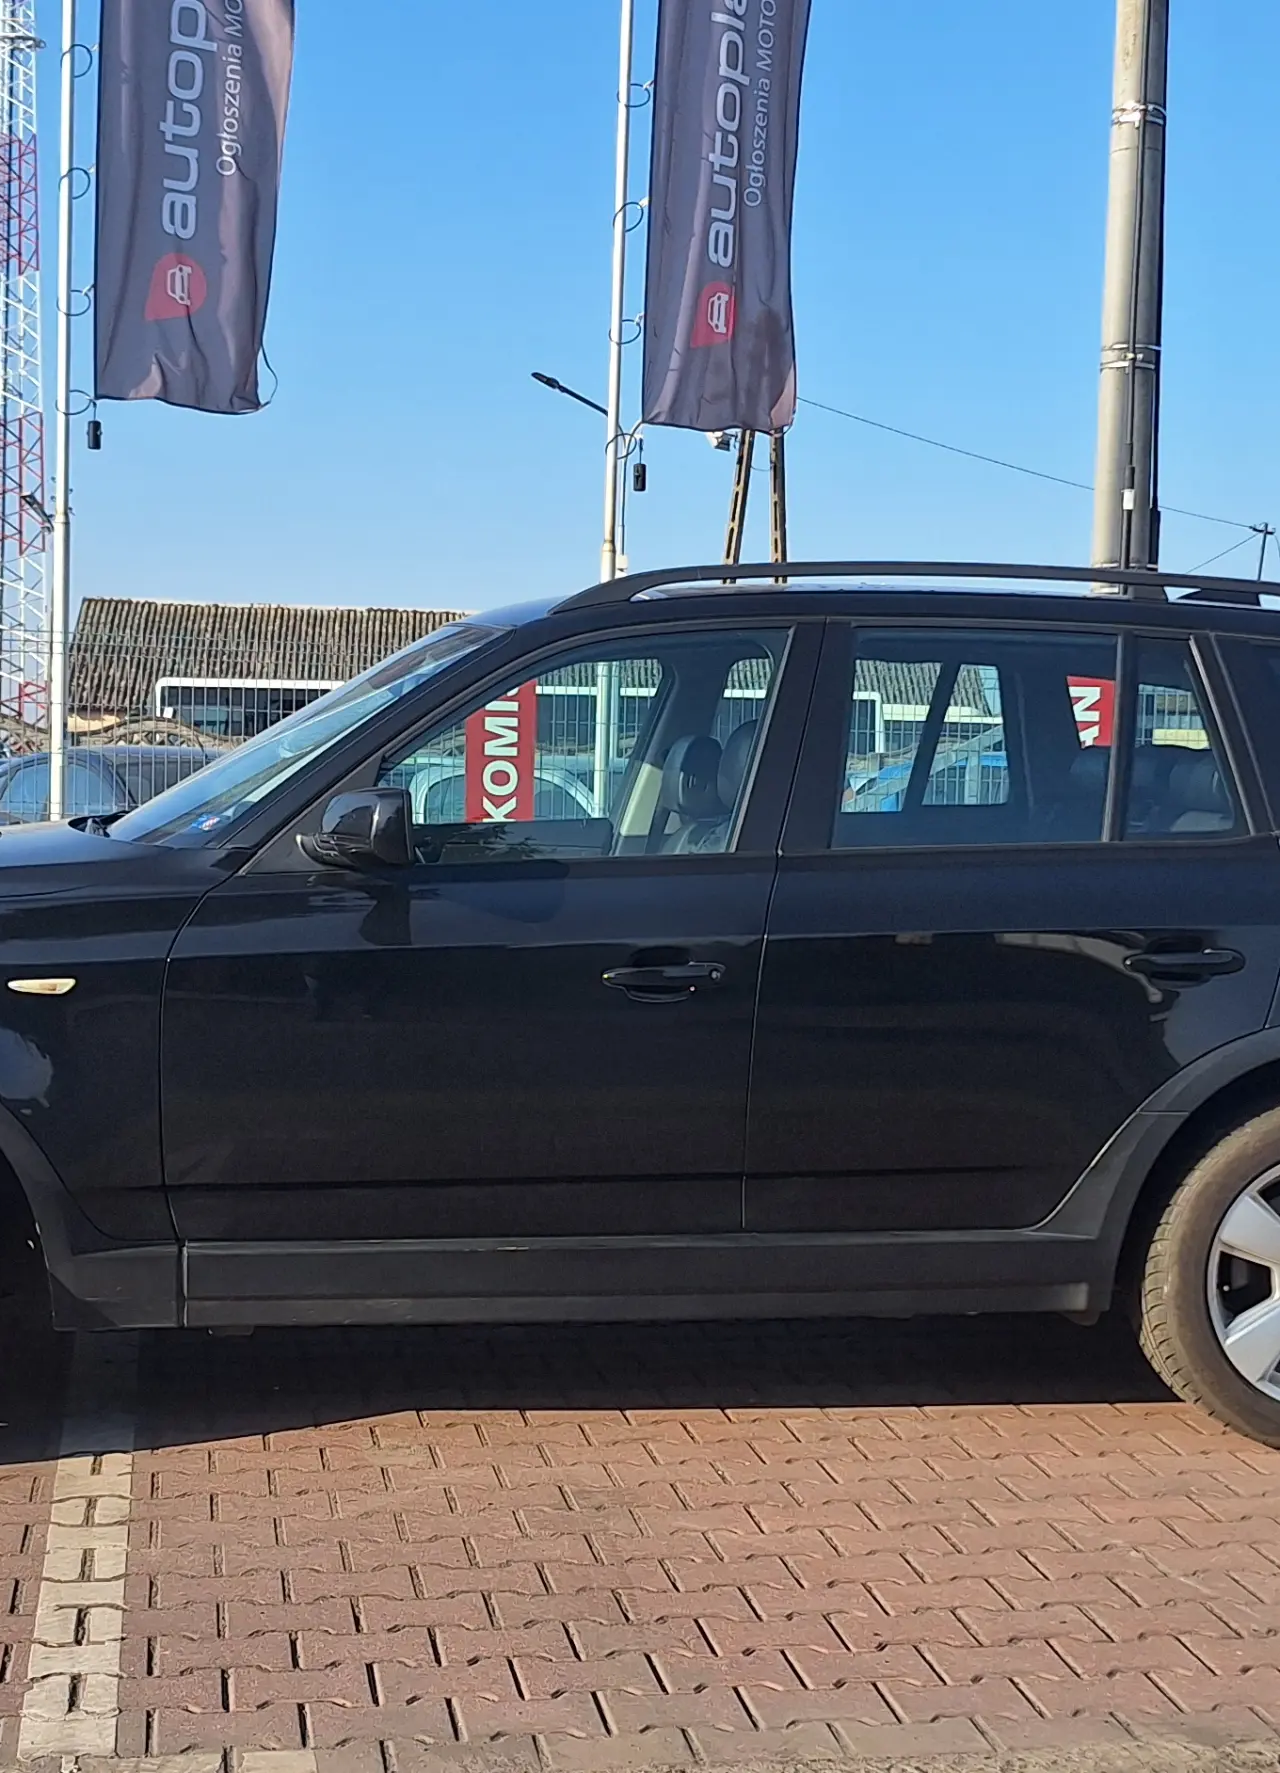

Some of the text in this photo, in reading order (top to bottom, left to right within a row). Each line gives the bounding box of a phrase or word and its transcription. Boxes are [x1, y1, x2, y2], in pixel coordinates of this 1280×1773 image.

[159, 0, 218, 240] autop
[216, 43, 242, 176] Ogłoszenia
[744, 0, 776, 208] Ogłoszenia MOTO
[482, 687, 519, 822] KOMI
